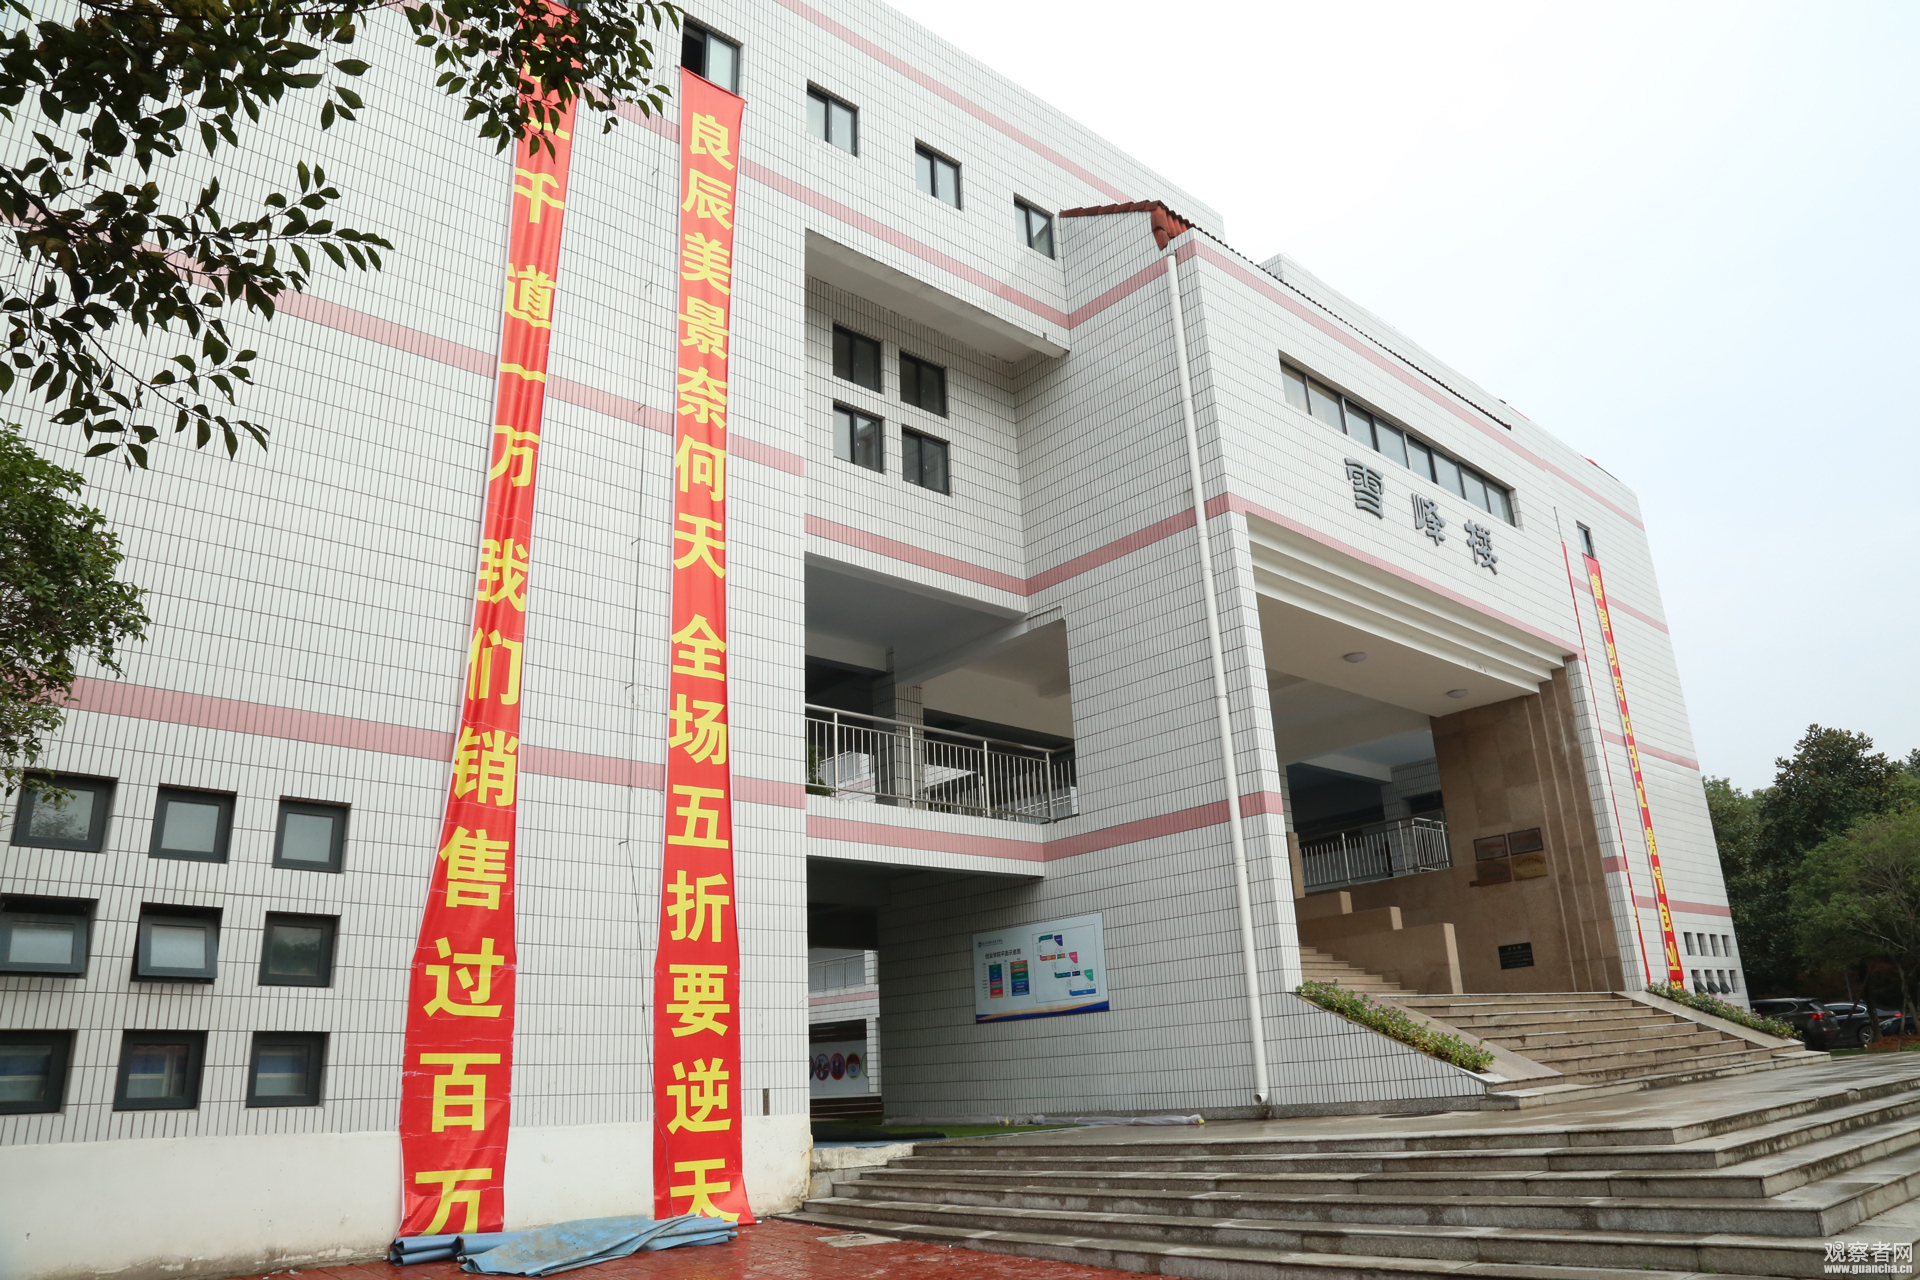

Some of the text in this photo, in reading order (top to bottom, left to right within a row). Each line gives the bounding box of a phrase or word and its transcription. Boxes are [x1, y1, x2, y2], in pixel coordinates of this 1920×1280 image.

[415, 39, 574, 1236] 一千道一万我们销售过百万
